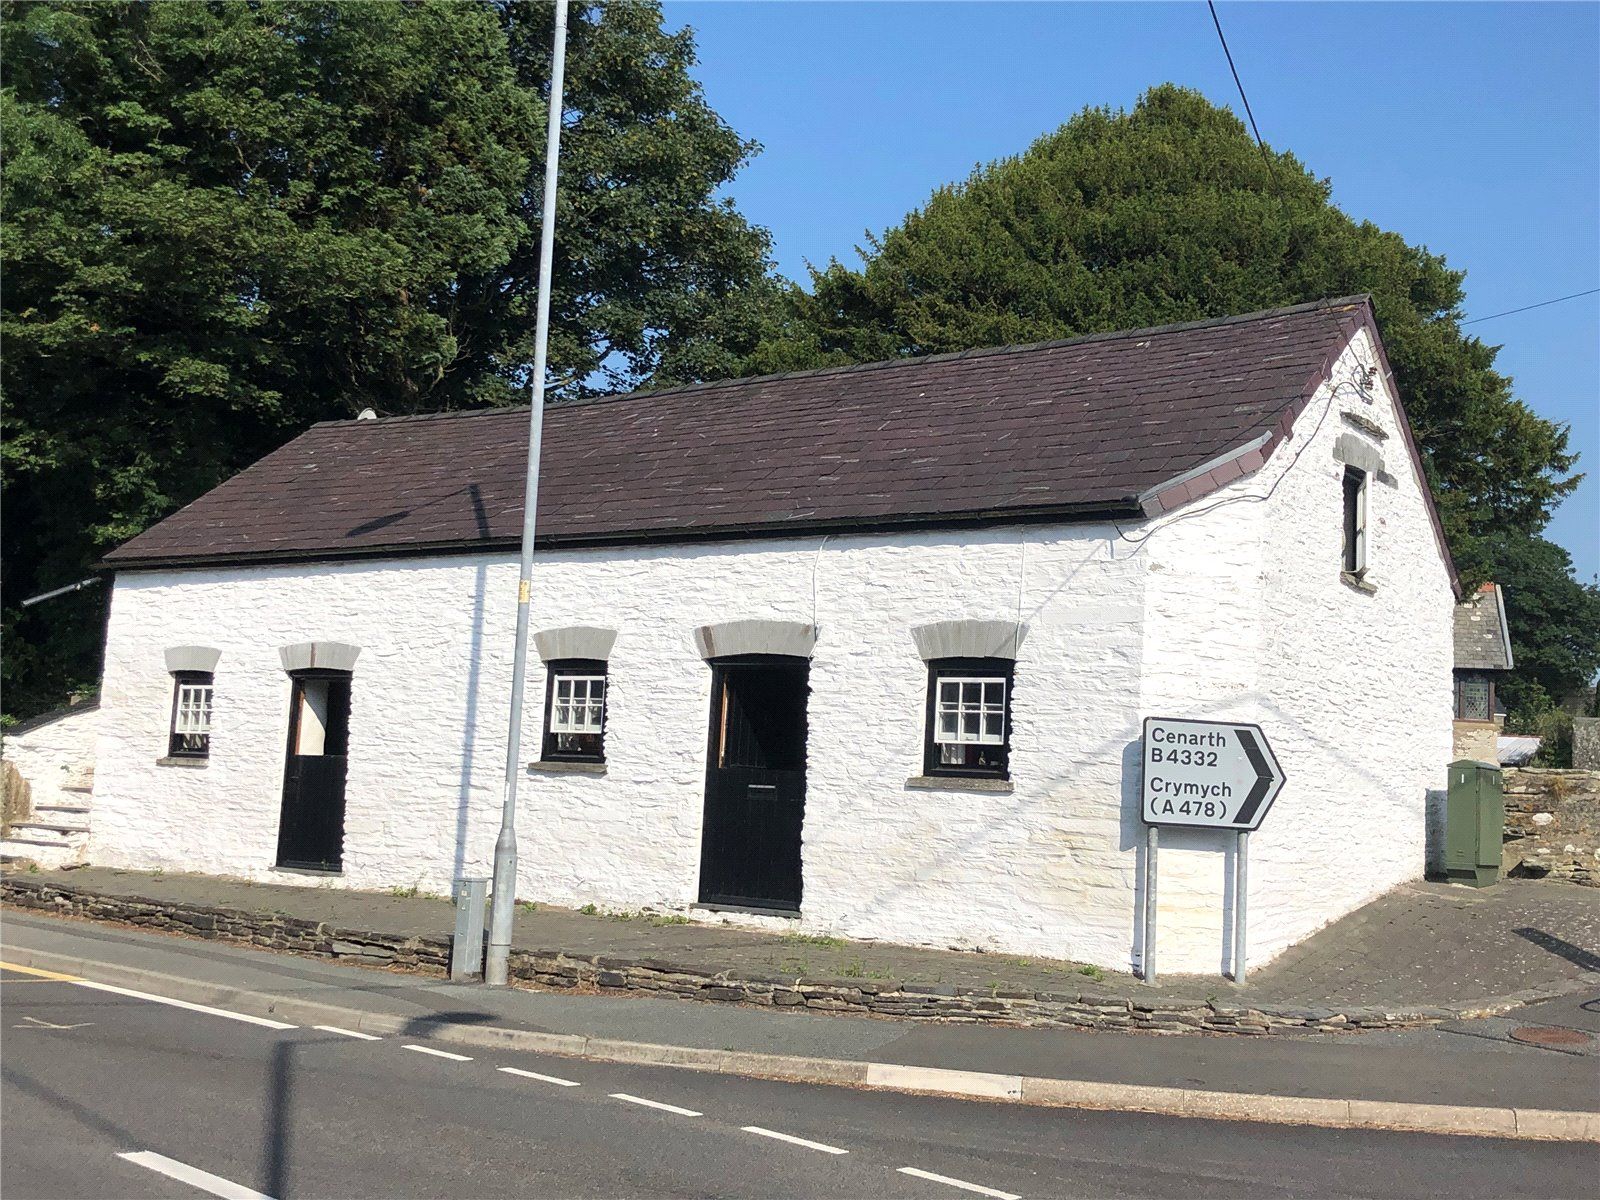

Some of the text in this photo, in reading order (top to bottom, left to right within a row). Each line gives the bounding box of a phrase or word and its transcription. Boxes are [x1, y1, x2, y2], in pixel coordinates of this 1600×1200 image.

[1152, 727, 1226, 748] Cenarth
[1151, 747, 1218, 767] B4332
[1150, 776, 1232, 799] Crymych
[1150, 796, 1227, 820] (A478)
